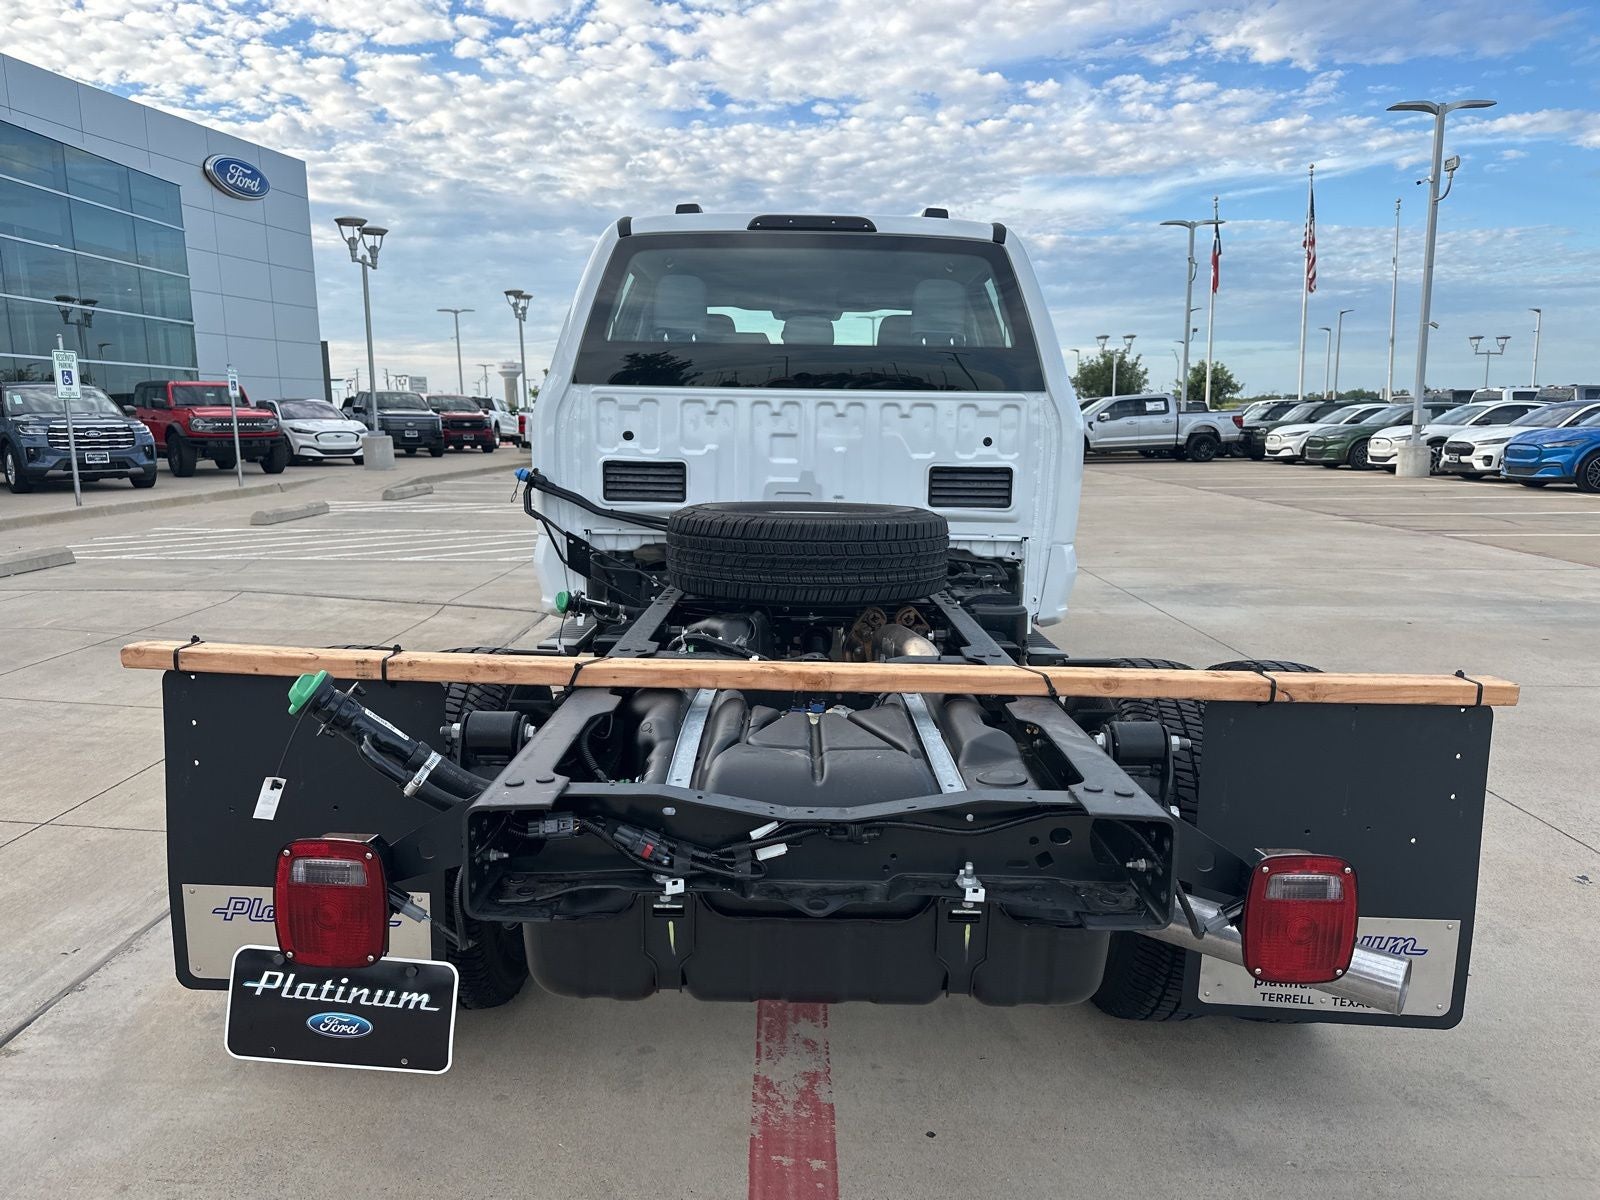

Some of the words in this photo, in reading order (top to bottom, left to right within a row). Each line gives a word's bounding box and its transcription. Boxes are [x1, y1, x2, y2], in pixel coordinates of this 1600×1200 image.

[226, 163, 261, 192] Ford
[55, 353, 75, 363] RESERVED
[58, 361, 74, 369] PARKING
[242, 970, 441, 1012] Platinum
[1260, 992, 1315, 1005] TERRELL
[1331, 996, 1372, 1009] TEXA
[319, 1015, 360, 1035] Ford
